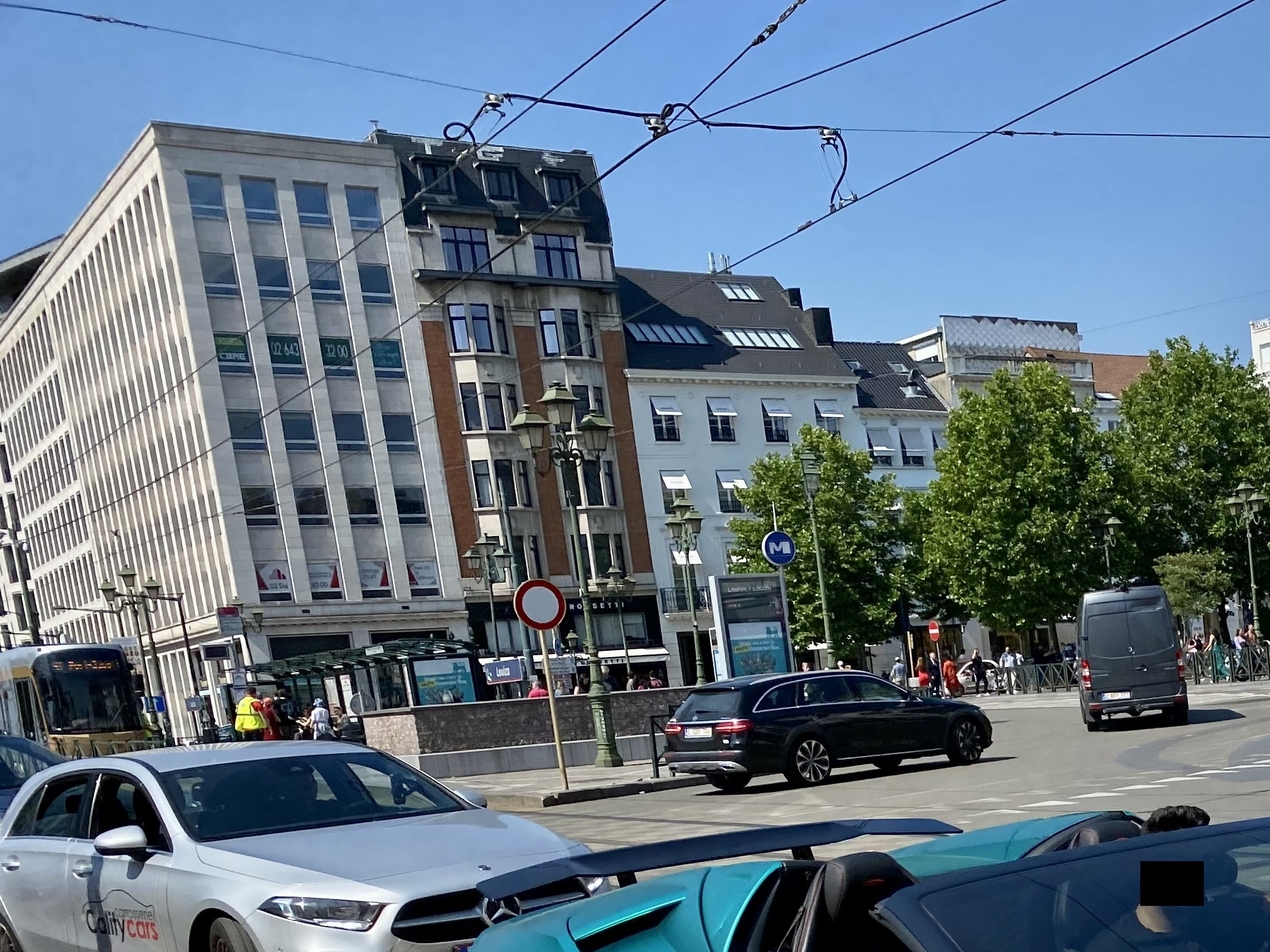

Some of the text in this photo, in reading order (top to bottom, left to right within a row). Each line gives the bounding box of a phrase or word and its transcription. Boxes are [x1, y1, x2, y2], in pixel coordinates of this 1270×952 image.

[271, 341, 300, 356] 02 643
[325, 343, 349, 359] 32 00
[569, 601, 625, 610] ROSETTI
